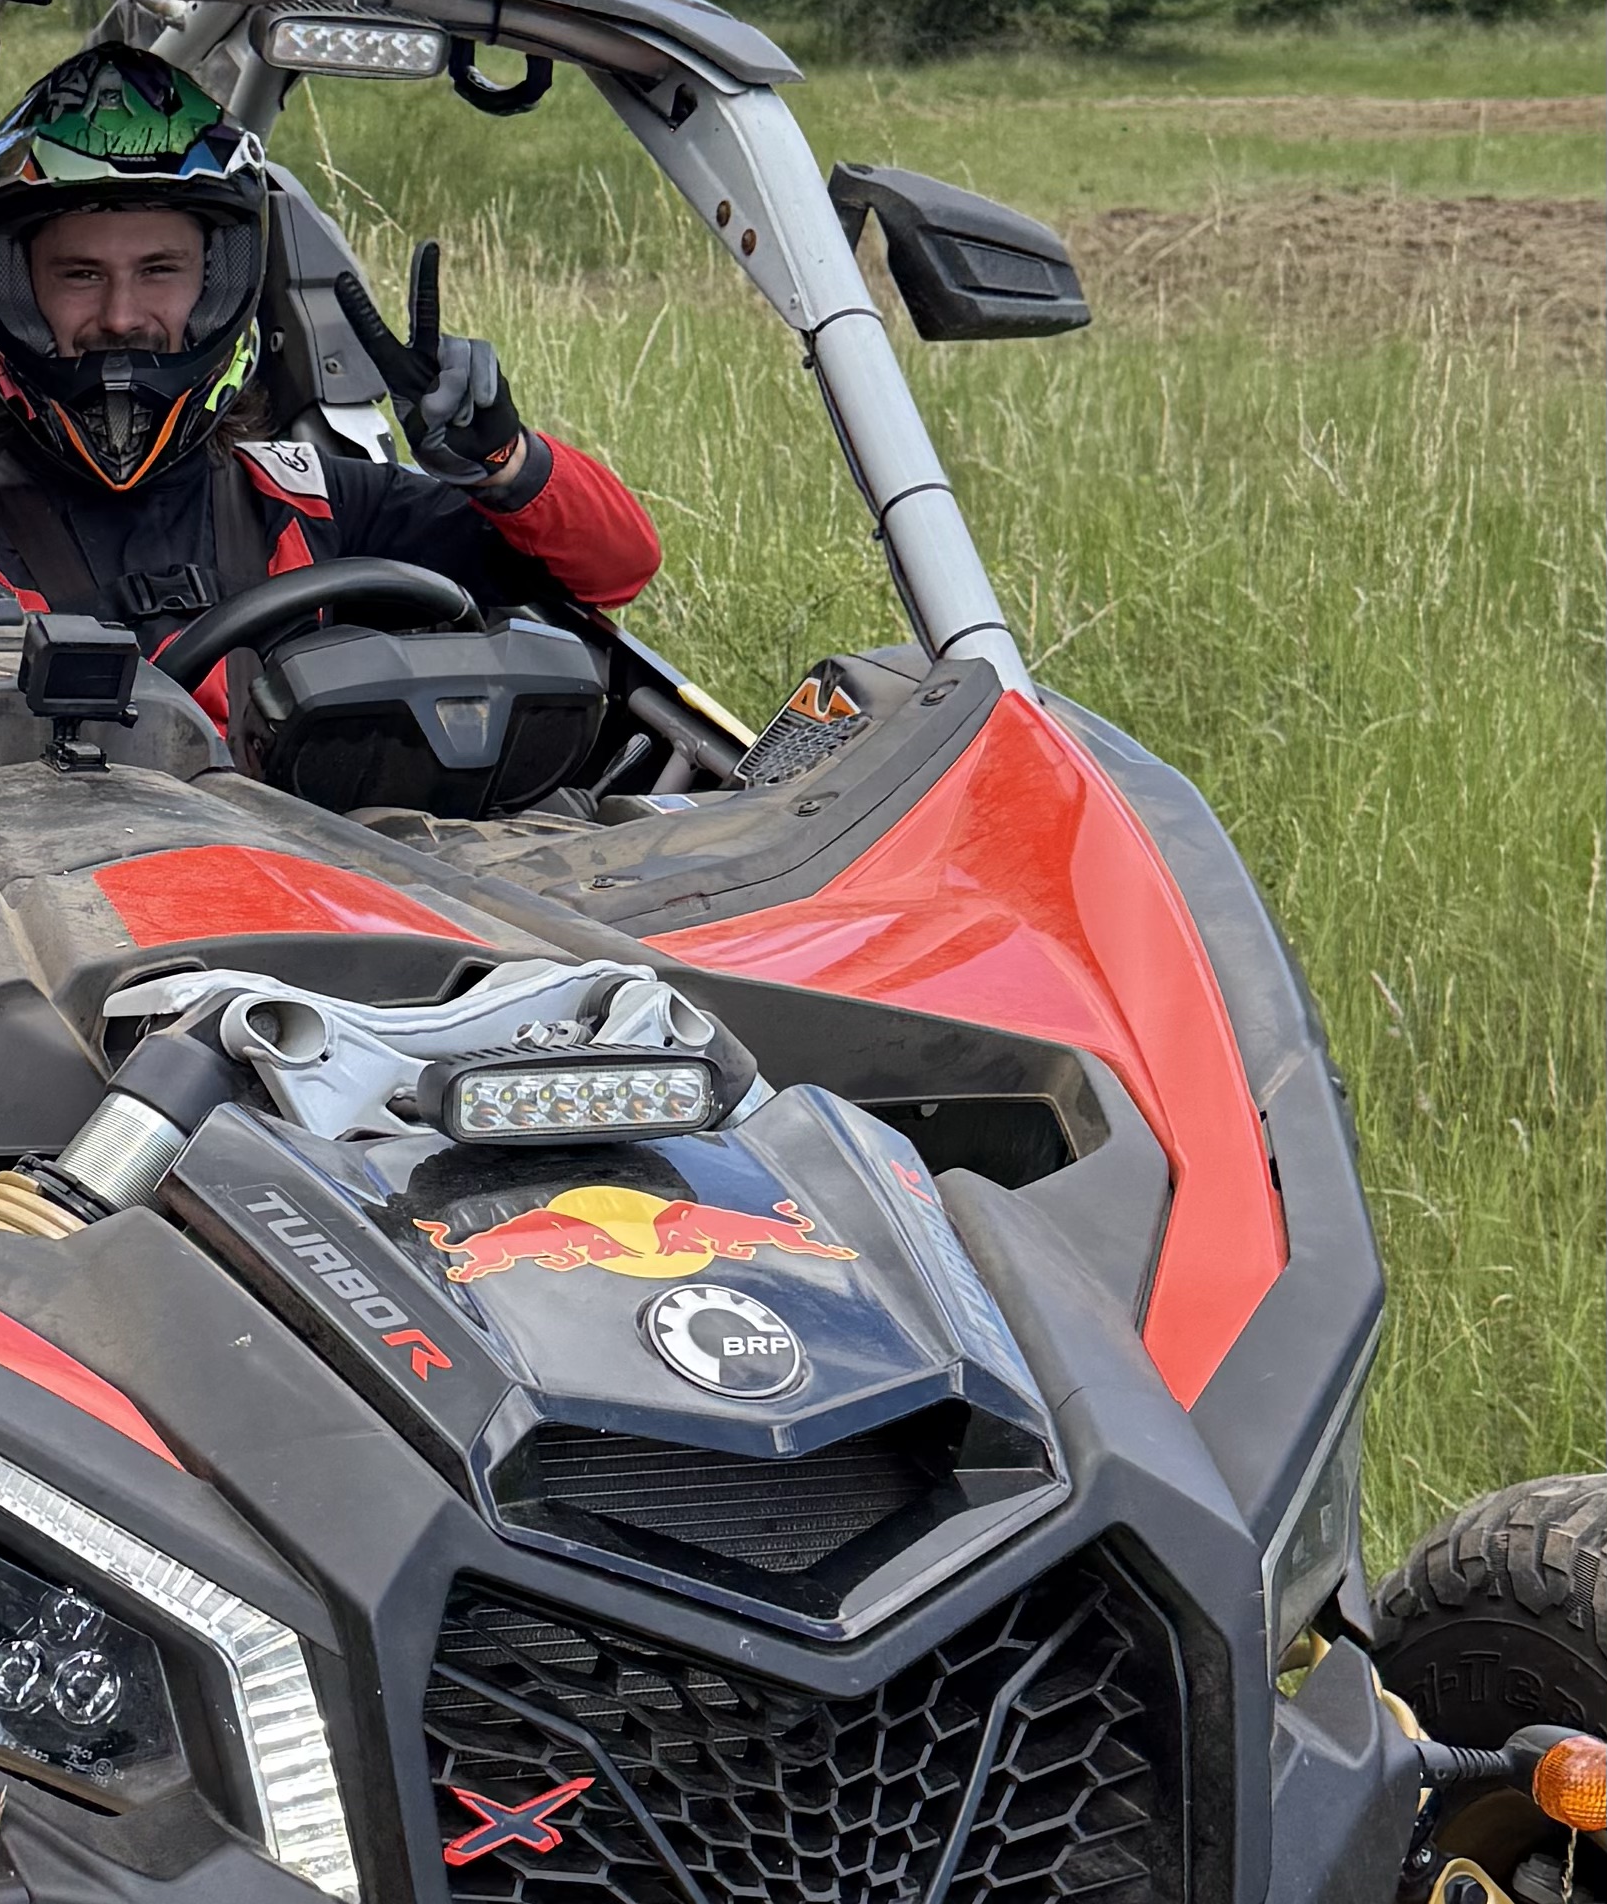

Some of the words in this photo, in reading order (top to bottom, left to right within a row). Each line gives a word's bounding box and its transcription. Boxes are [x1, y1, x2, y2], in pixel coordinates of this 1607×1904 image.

[245, 1190, 409, 1329] TURBO
[381, 1328, 453, 1382] R
[722, 1335, 791, 1357] BRP
